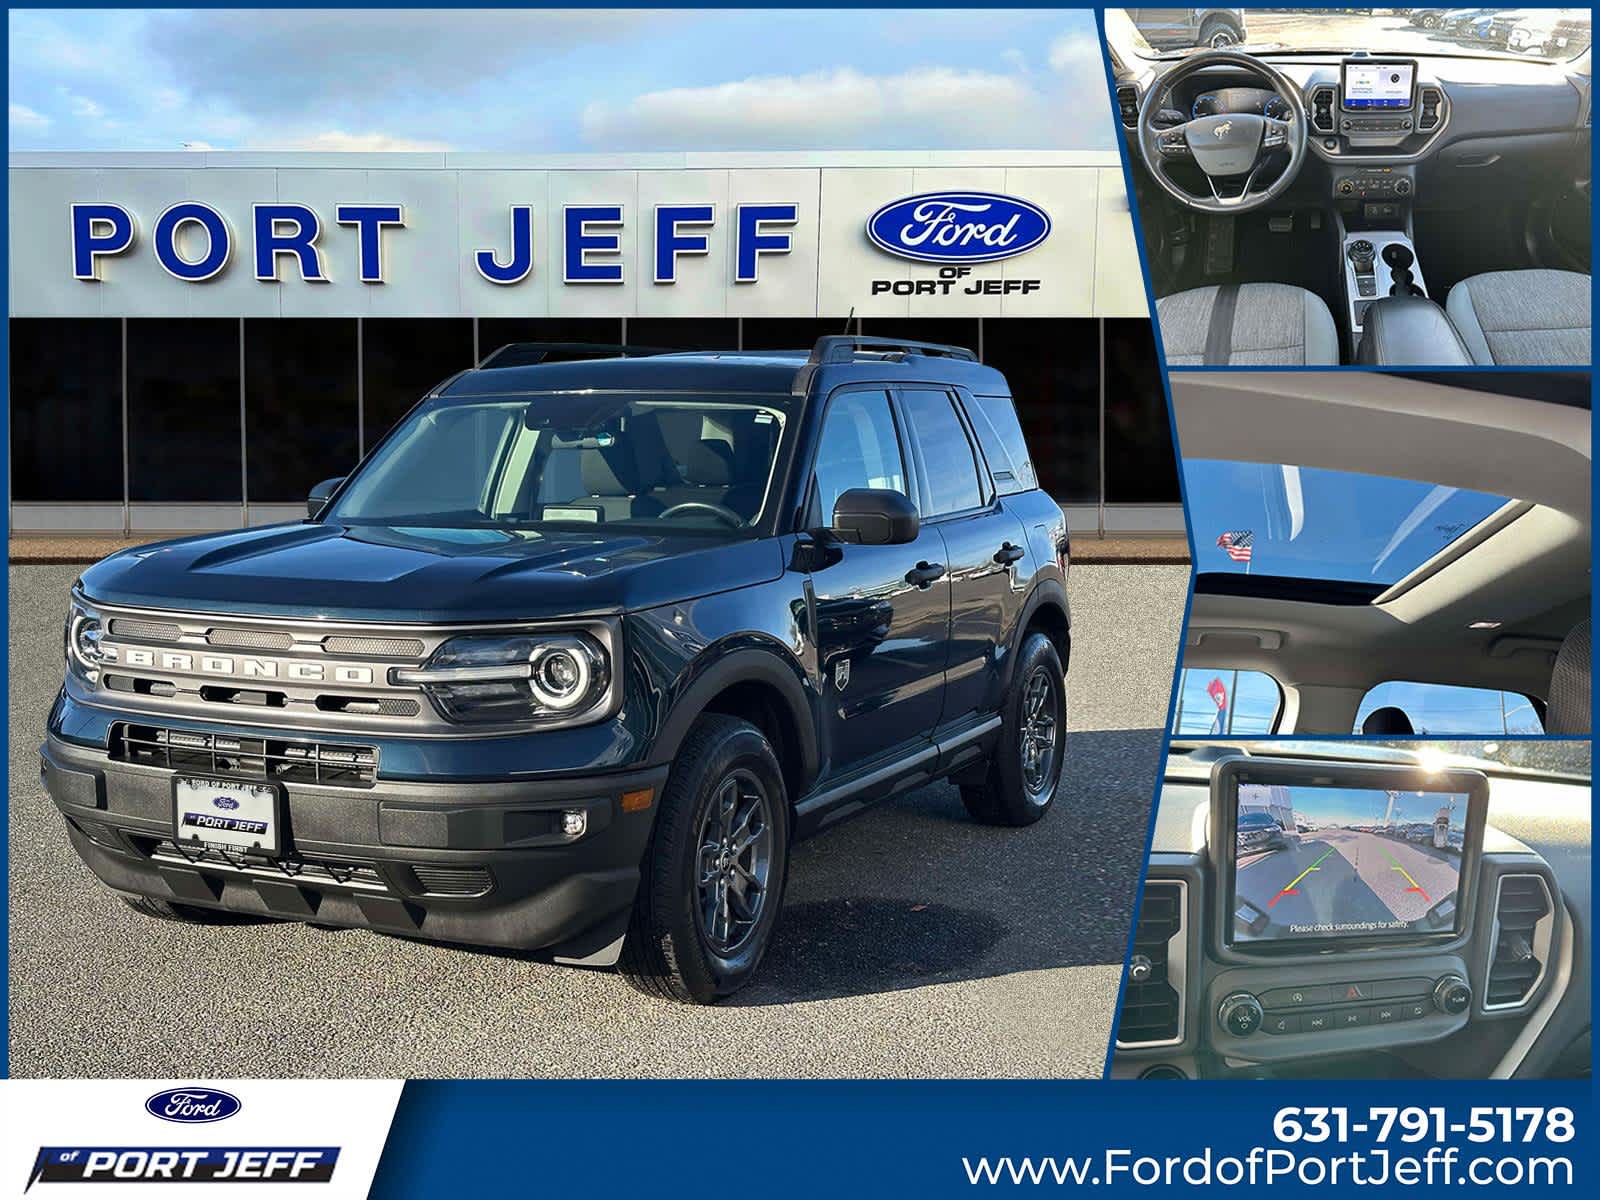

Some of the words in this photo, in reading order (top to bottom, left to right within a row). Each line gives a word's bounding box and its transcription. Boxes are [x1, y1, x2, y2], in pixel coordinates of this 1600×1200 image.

[900, 200, 1022, 246] Ford
[70, 201, 406, 283] PORT
[473, 202, 800, 284] JEFF
[939, 267, 972, 279] OF
[871, 280, 957, 296] PORT
[964, 279, 1041, 295] JEFF
[126, 649, 373, 684] BRONCO
[196, 815, 230, 829] PORT
[231, 821, 264, 833] JEFF
[1290, 923, 1313, 933] Please
[1314, 922, 1334, 932] check
[1335, 920, 1377, 931] surroundings
[1377, 919, 1387, 929] for
